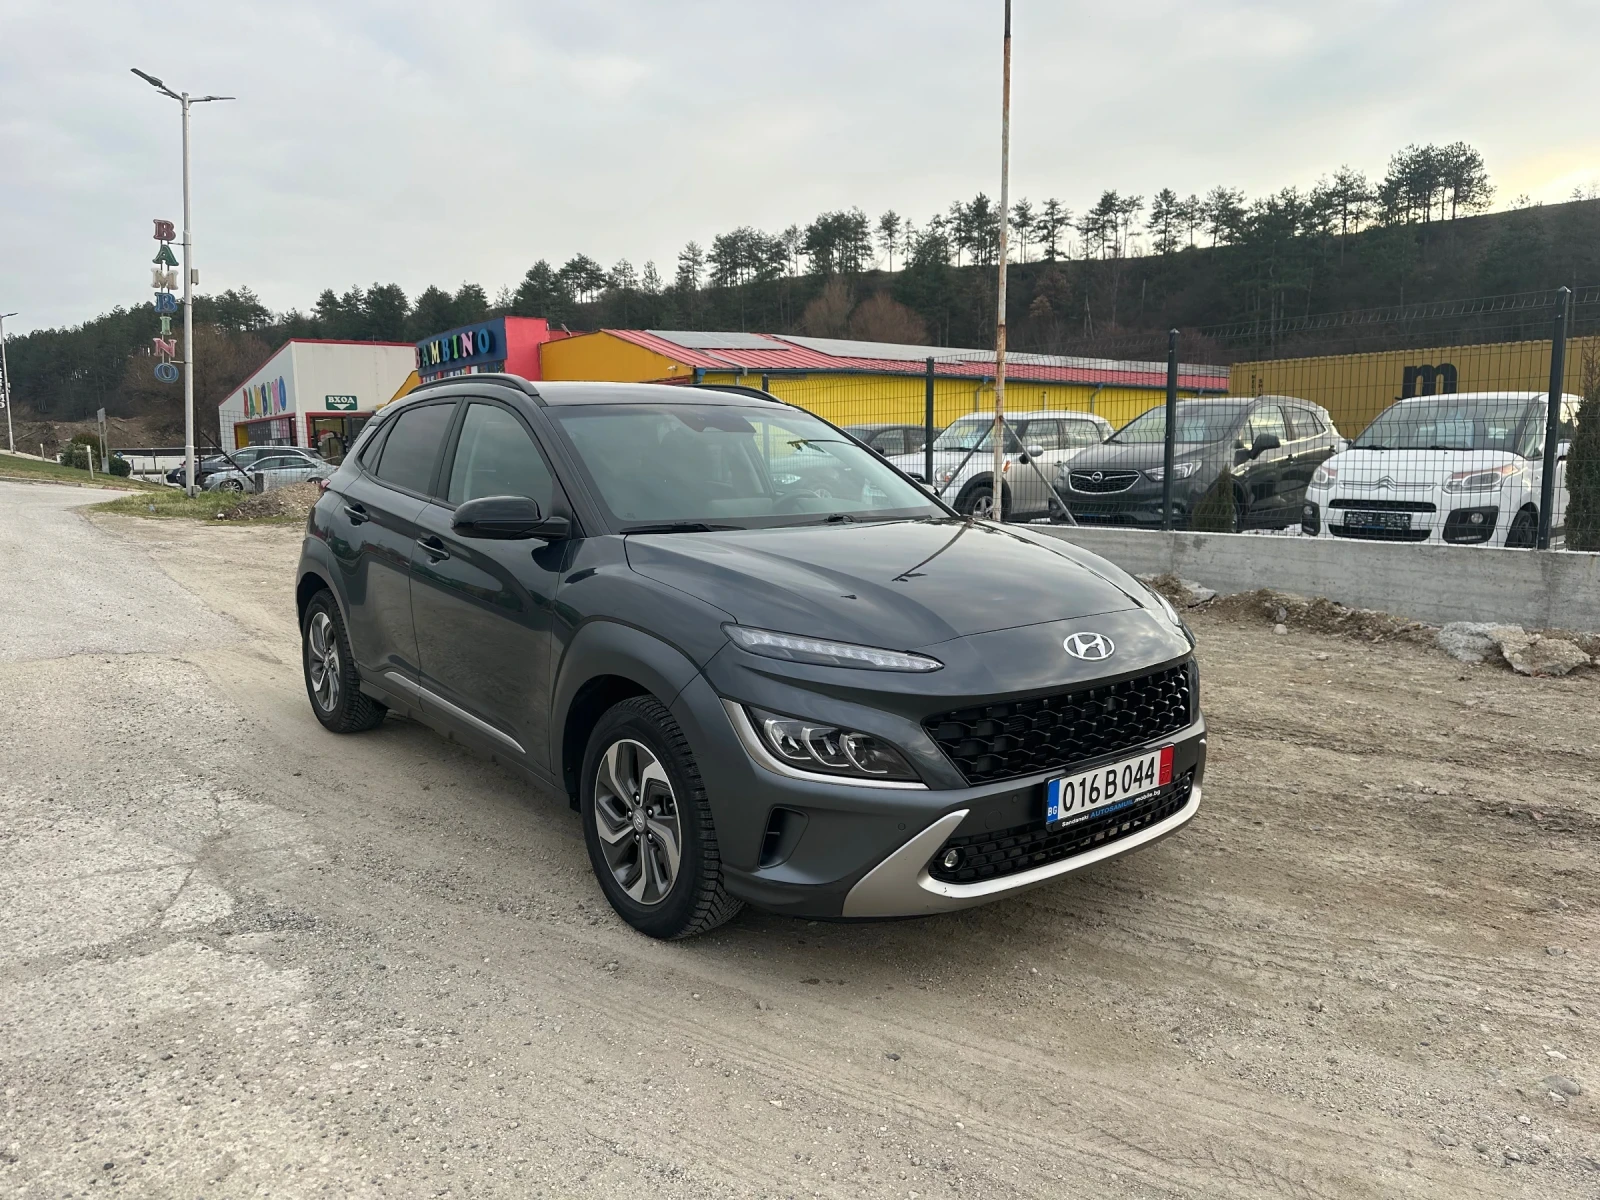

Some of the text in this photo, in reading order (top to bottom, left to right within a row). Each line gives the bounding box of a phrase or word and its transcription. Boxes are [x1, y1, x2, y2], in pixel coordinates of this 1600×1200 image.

[152, 219, 180, 384] BAMBINO
[415, 328, 491, 370] BAMBINO
[242, 375, 287, 419] BAMBINO
[1047, 806, 1058, 817] BG
